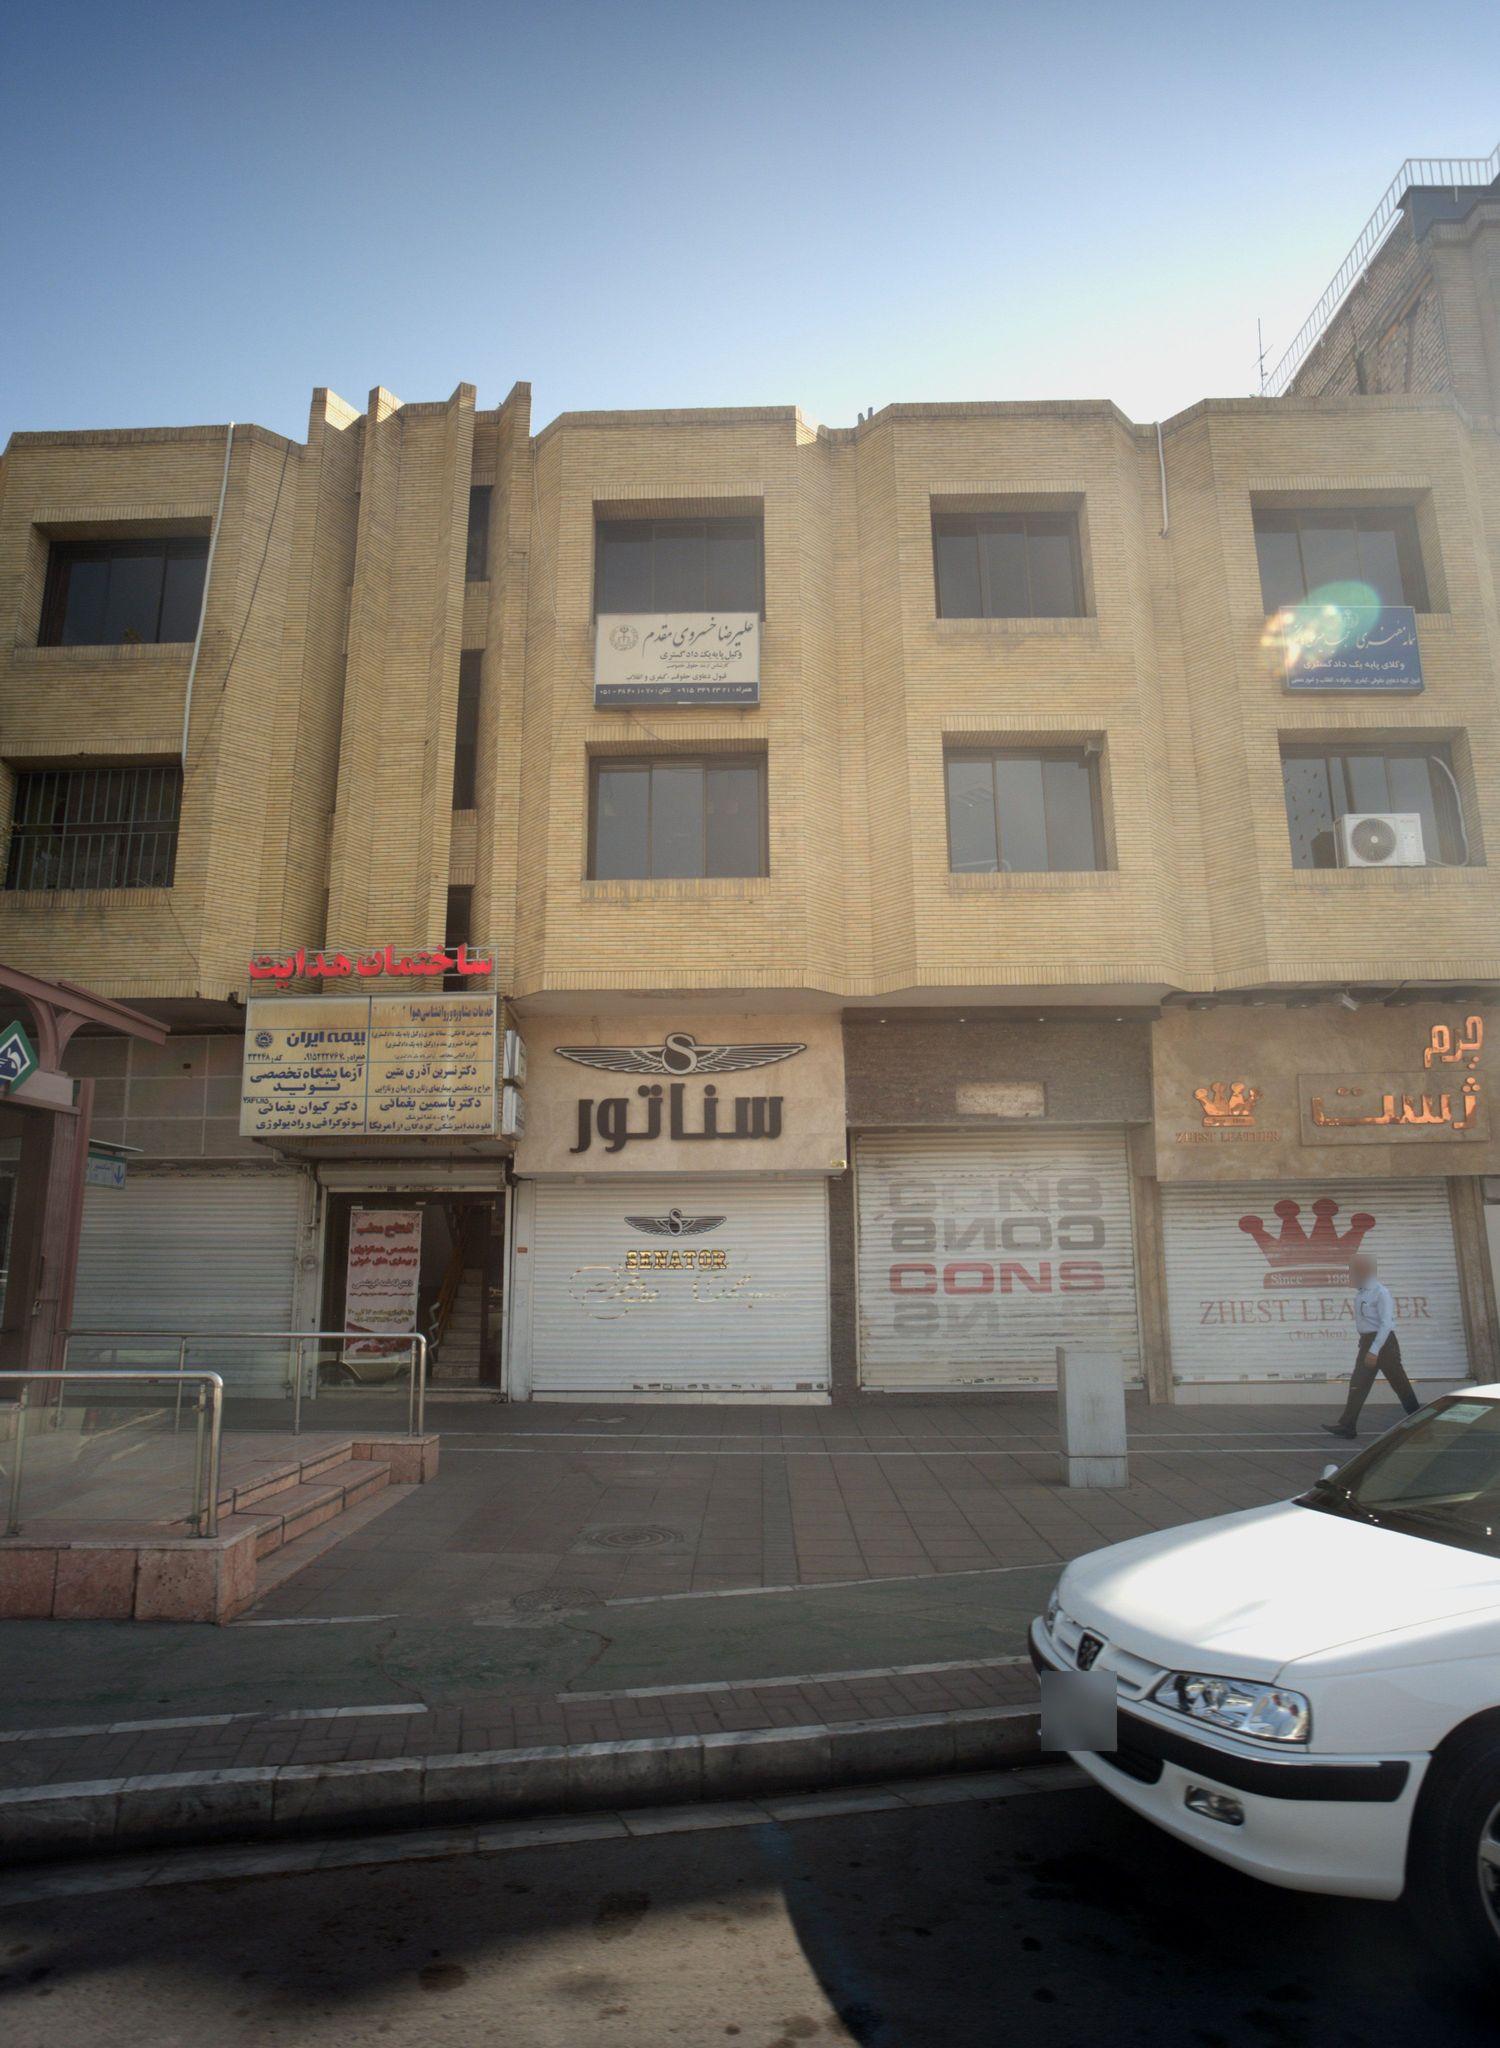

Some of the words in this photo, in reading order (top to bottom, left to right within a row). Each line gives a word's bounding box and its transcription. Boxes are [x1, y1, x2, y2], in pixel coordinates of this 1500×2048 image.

[672, 616, 718, 648] خسروی
[718, 620, 754, 647] علیرضا
[642, 624, 673, 659] مقدم
[660, 650, 699, 661] دادگستری
[711, 650, 725, 660] پایه
[725, 649, 743, 661] وکیل
[1303, 660, 1347, 671] دادگستری
[1348, 660, 1362, 669] یک
[1365, 660, 1381, 670] پایه
[1381, 659, 1406, 671] وکلای
[249, 944, 351, 988] هدایت
[357, 943, 493, 978] ساختمان
[286, 1030, 325, 1048] ایران
[327, 1030, 366, 1046] بیمه
[1424, 1015, 1484, 1069] چرم
[249, 1066, 302, 1083] تخصصی
[303, 1063, 364, 1082] آزمایشگاه
[385, 1066, 405, 1080] متین
[405, 1062, 432, 1079] آذری
[432, 1065, 458, 1079] نسرین
[458, 1064, 477, 1079] دکتر
[273, 1081, 341, 1096] نوید
[298, 1100, 330, 1115] کیوان
[332, 1100, 358, 1115] دکتر
[419, 1097, 456, 1111] یاسمین
[457, 1096, 481, 1111] دکتر
[1311, 1076, 1481, 1129] ژست
[255, 1118, 305, 1131] رادیولوژی
[569, 1082, 784, 1153] سناتور
[626, 1249, 729, 1271] SENATOR
[889, 1261, 1106, 1295] CONS
[1270, 1273, 1303, 1285] Since
[1200, 1299, 1290, 1325] ZHEST
[1302, 1296, 1432, 1322] LEAER
